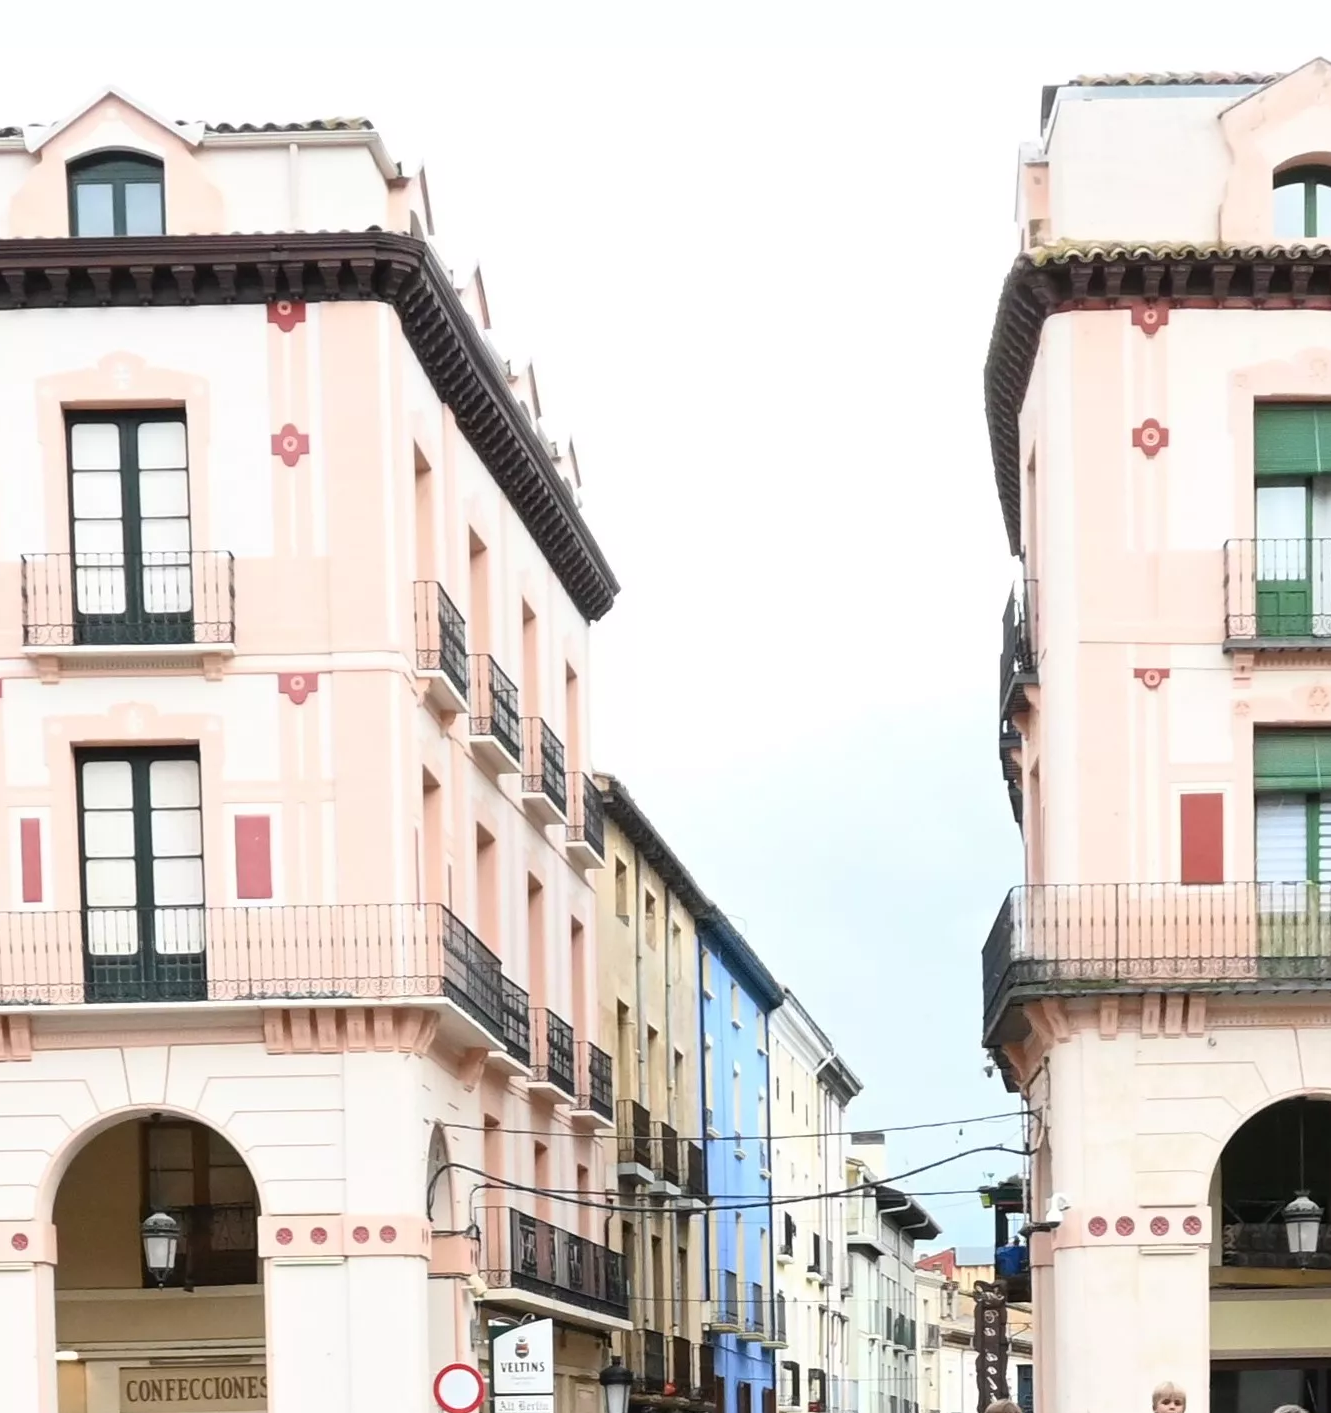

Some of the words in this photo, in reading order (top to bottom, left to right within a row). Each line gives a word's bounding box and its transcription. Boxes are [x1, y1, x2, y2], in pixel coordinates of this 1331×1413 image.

[500, 1362, 545, 1373] VELTINS
[126, 1376, 266, 1402] CONFECCIONES
[499, 1401, 515, 1411] Alt
[518, 1401, 549, 1411] Berlin
